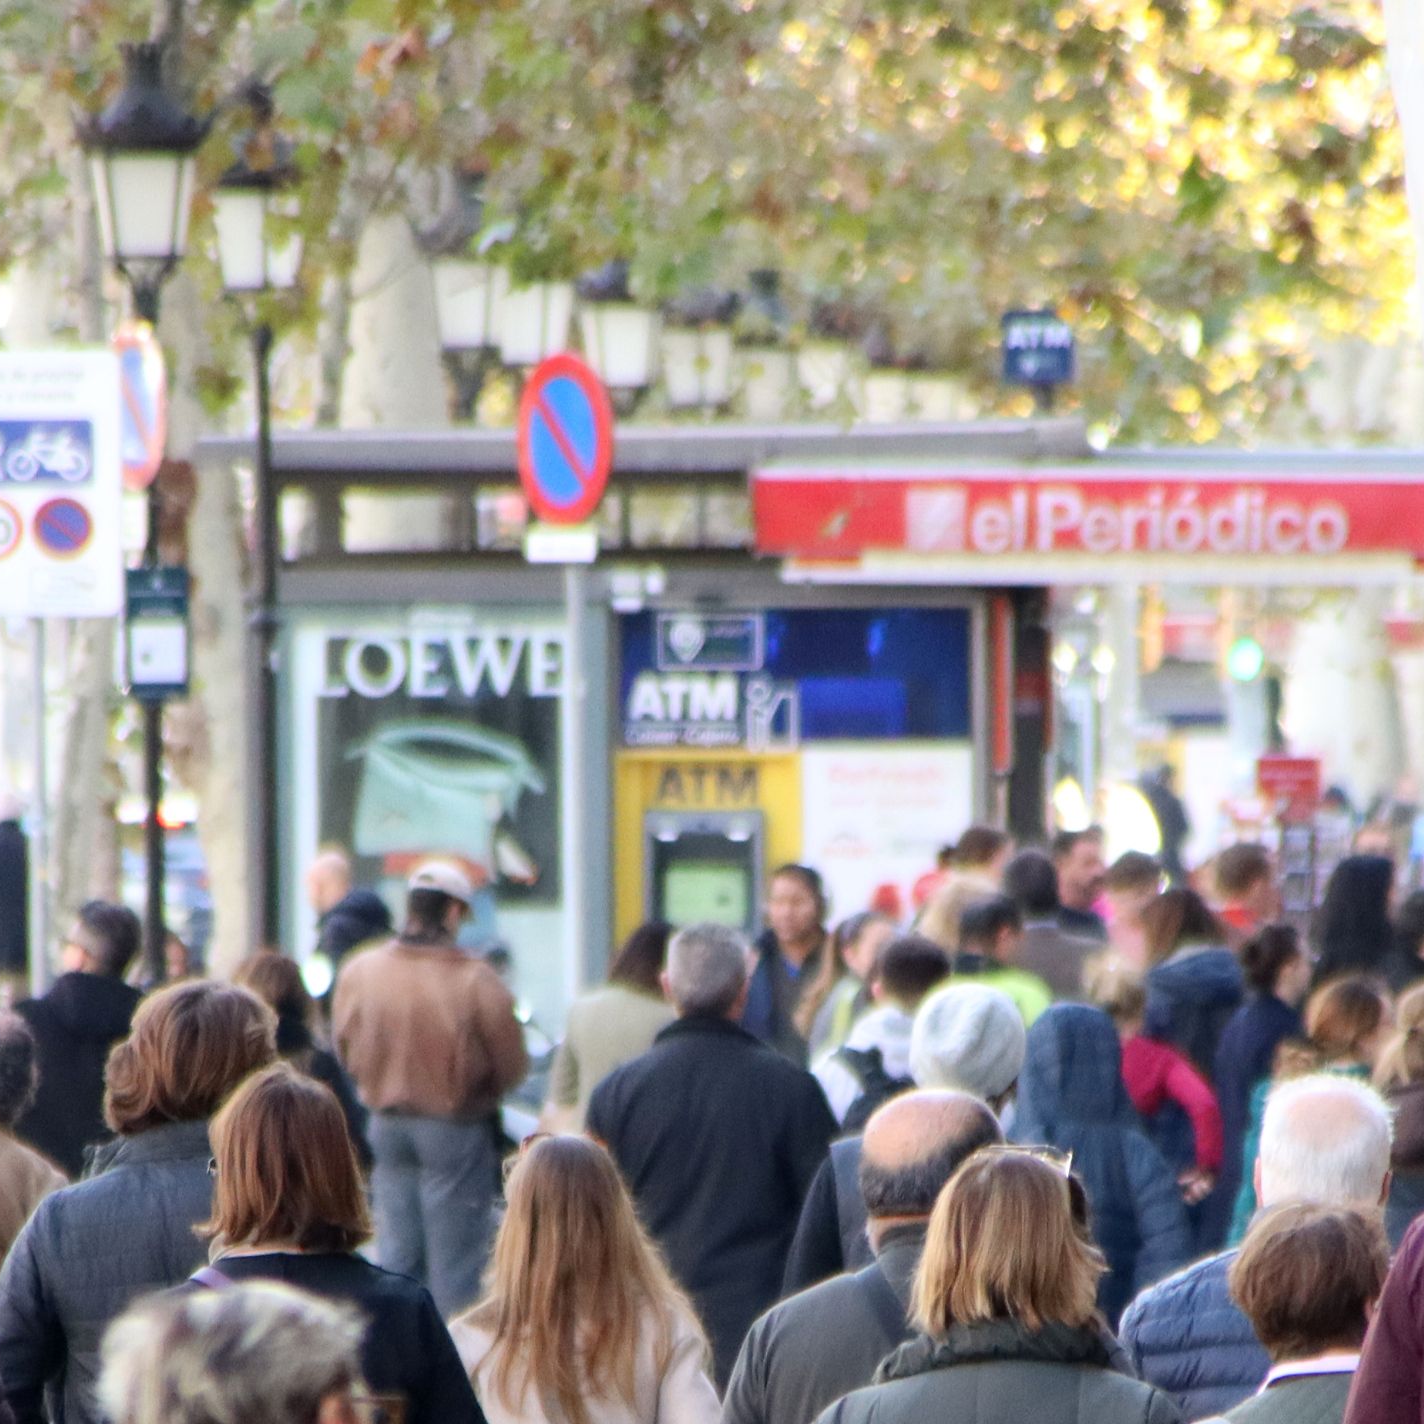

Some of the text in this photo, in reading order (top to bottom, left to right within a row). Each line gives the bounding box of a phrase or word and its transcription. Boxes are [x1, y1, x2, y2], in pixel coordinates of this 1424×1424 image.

[972, 485, 1349, 556] el Periódico
[314, 634, 564, 698] LOEWE
[629, 674, 739, 721] ATM
[661, 765, 760, 805] ATM
